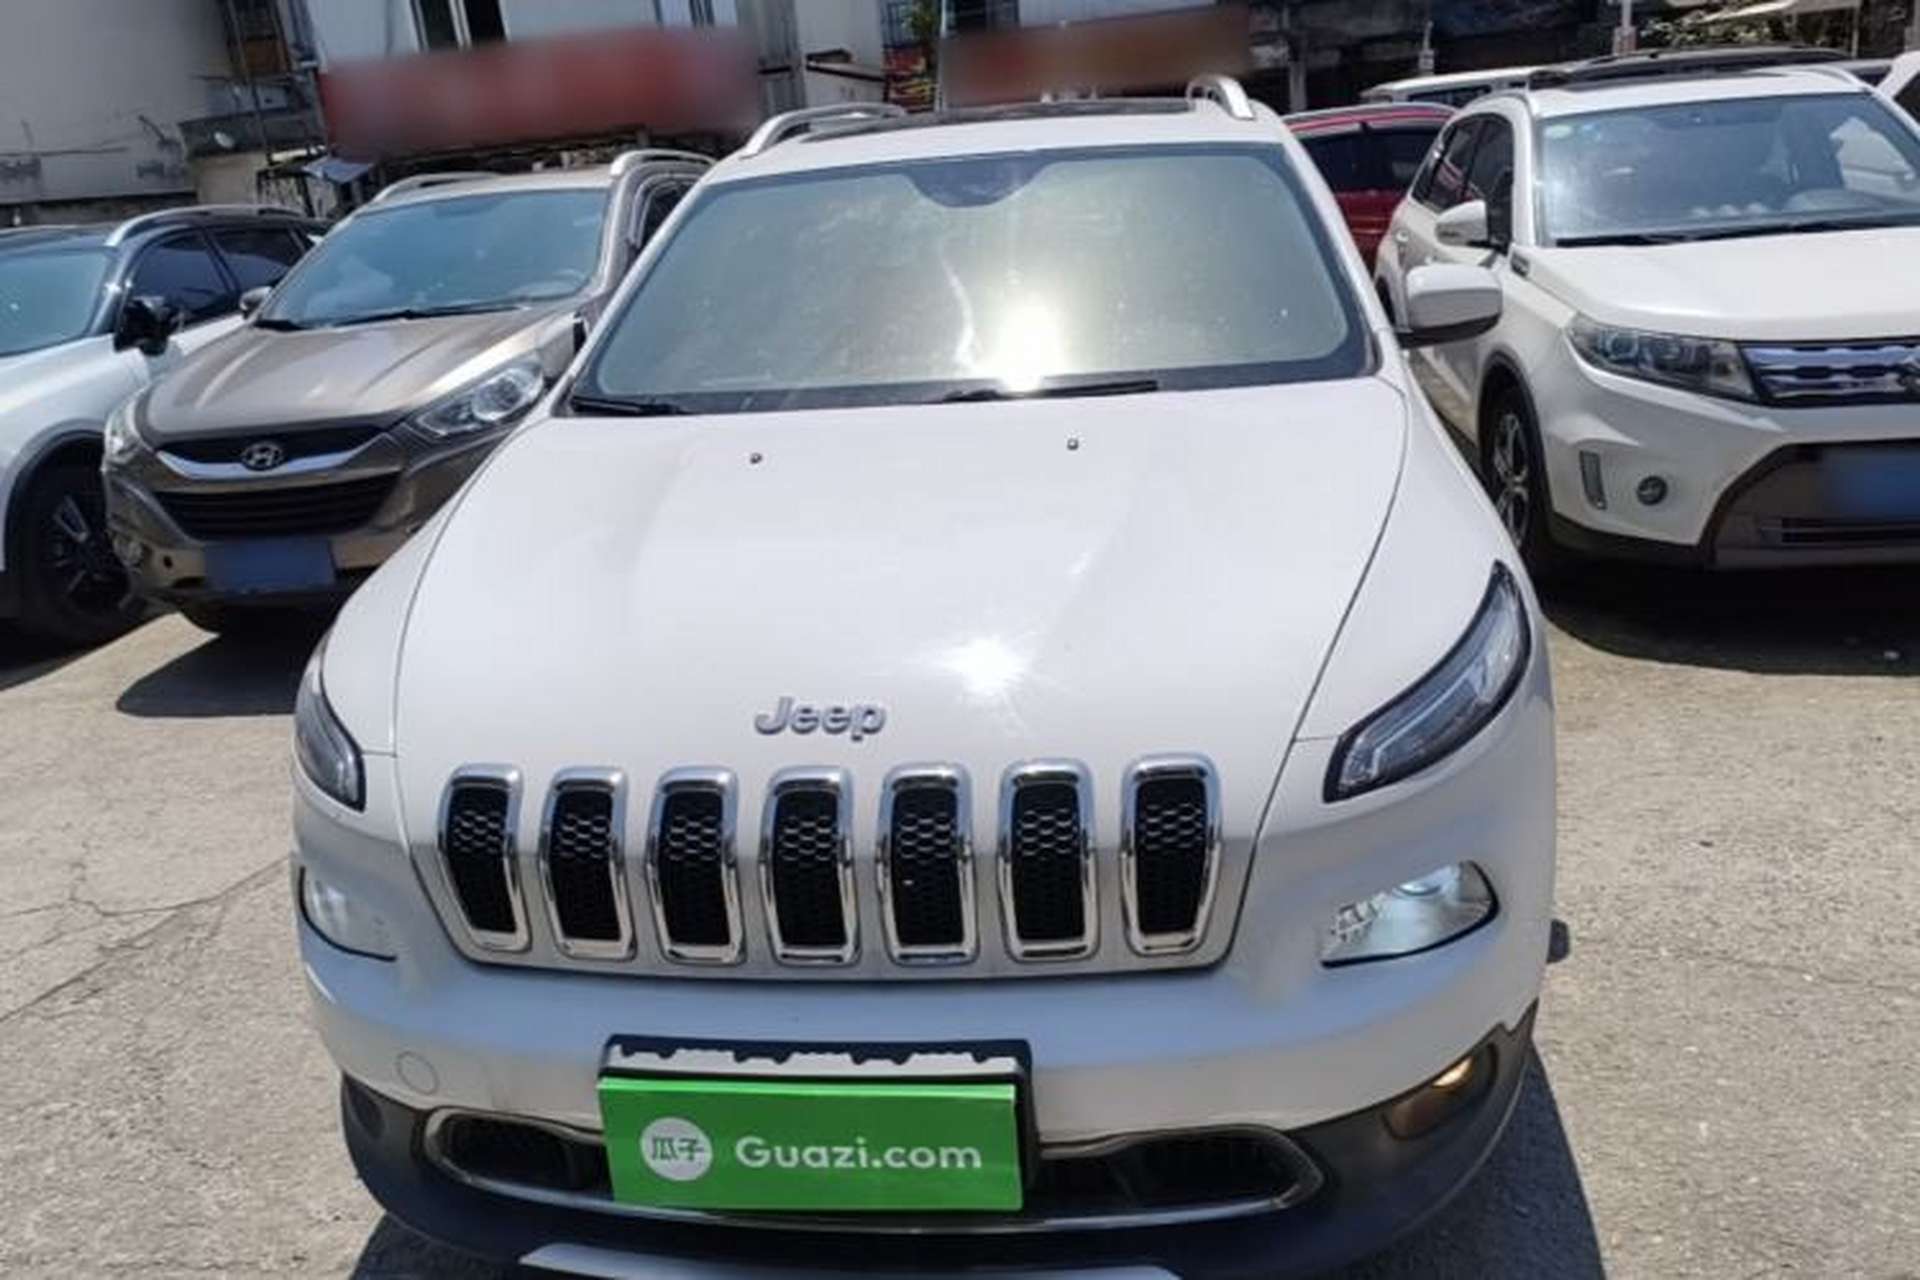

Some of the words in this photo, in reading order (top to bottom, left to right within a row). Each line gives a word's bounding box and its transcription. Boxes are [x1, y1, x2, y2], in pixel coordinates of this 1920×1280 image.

[755, 697, 887, 742] Jeep
[651, 1136, 704, 1162] 瓜子
[736, 1135, 982, 1169] Guazi.com
